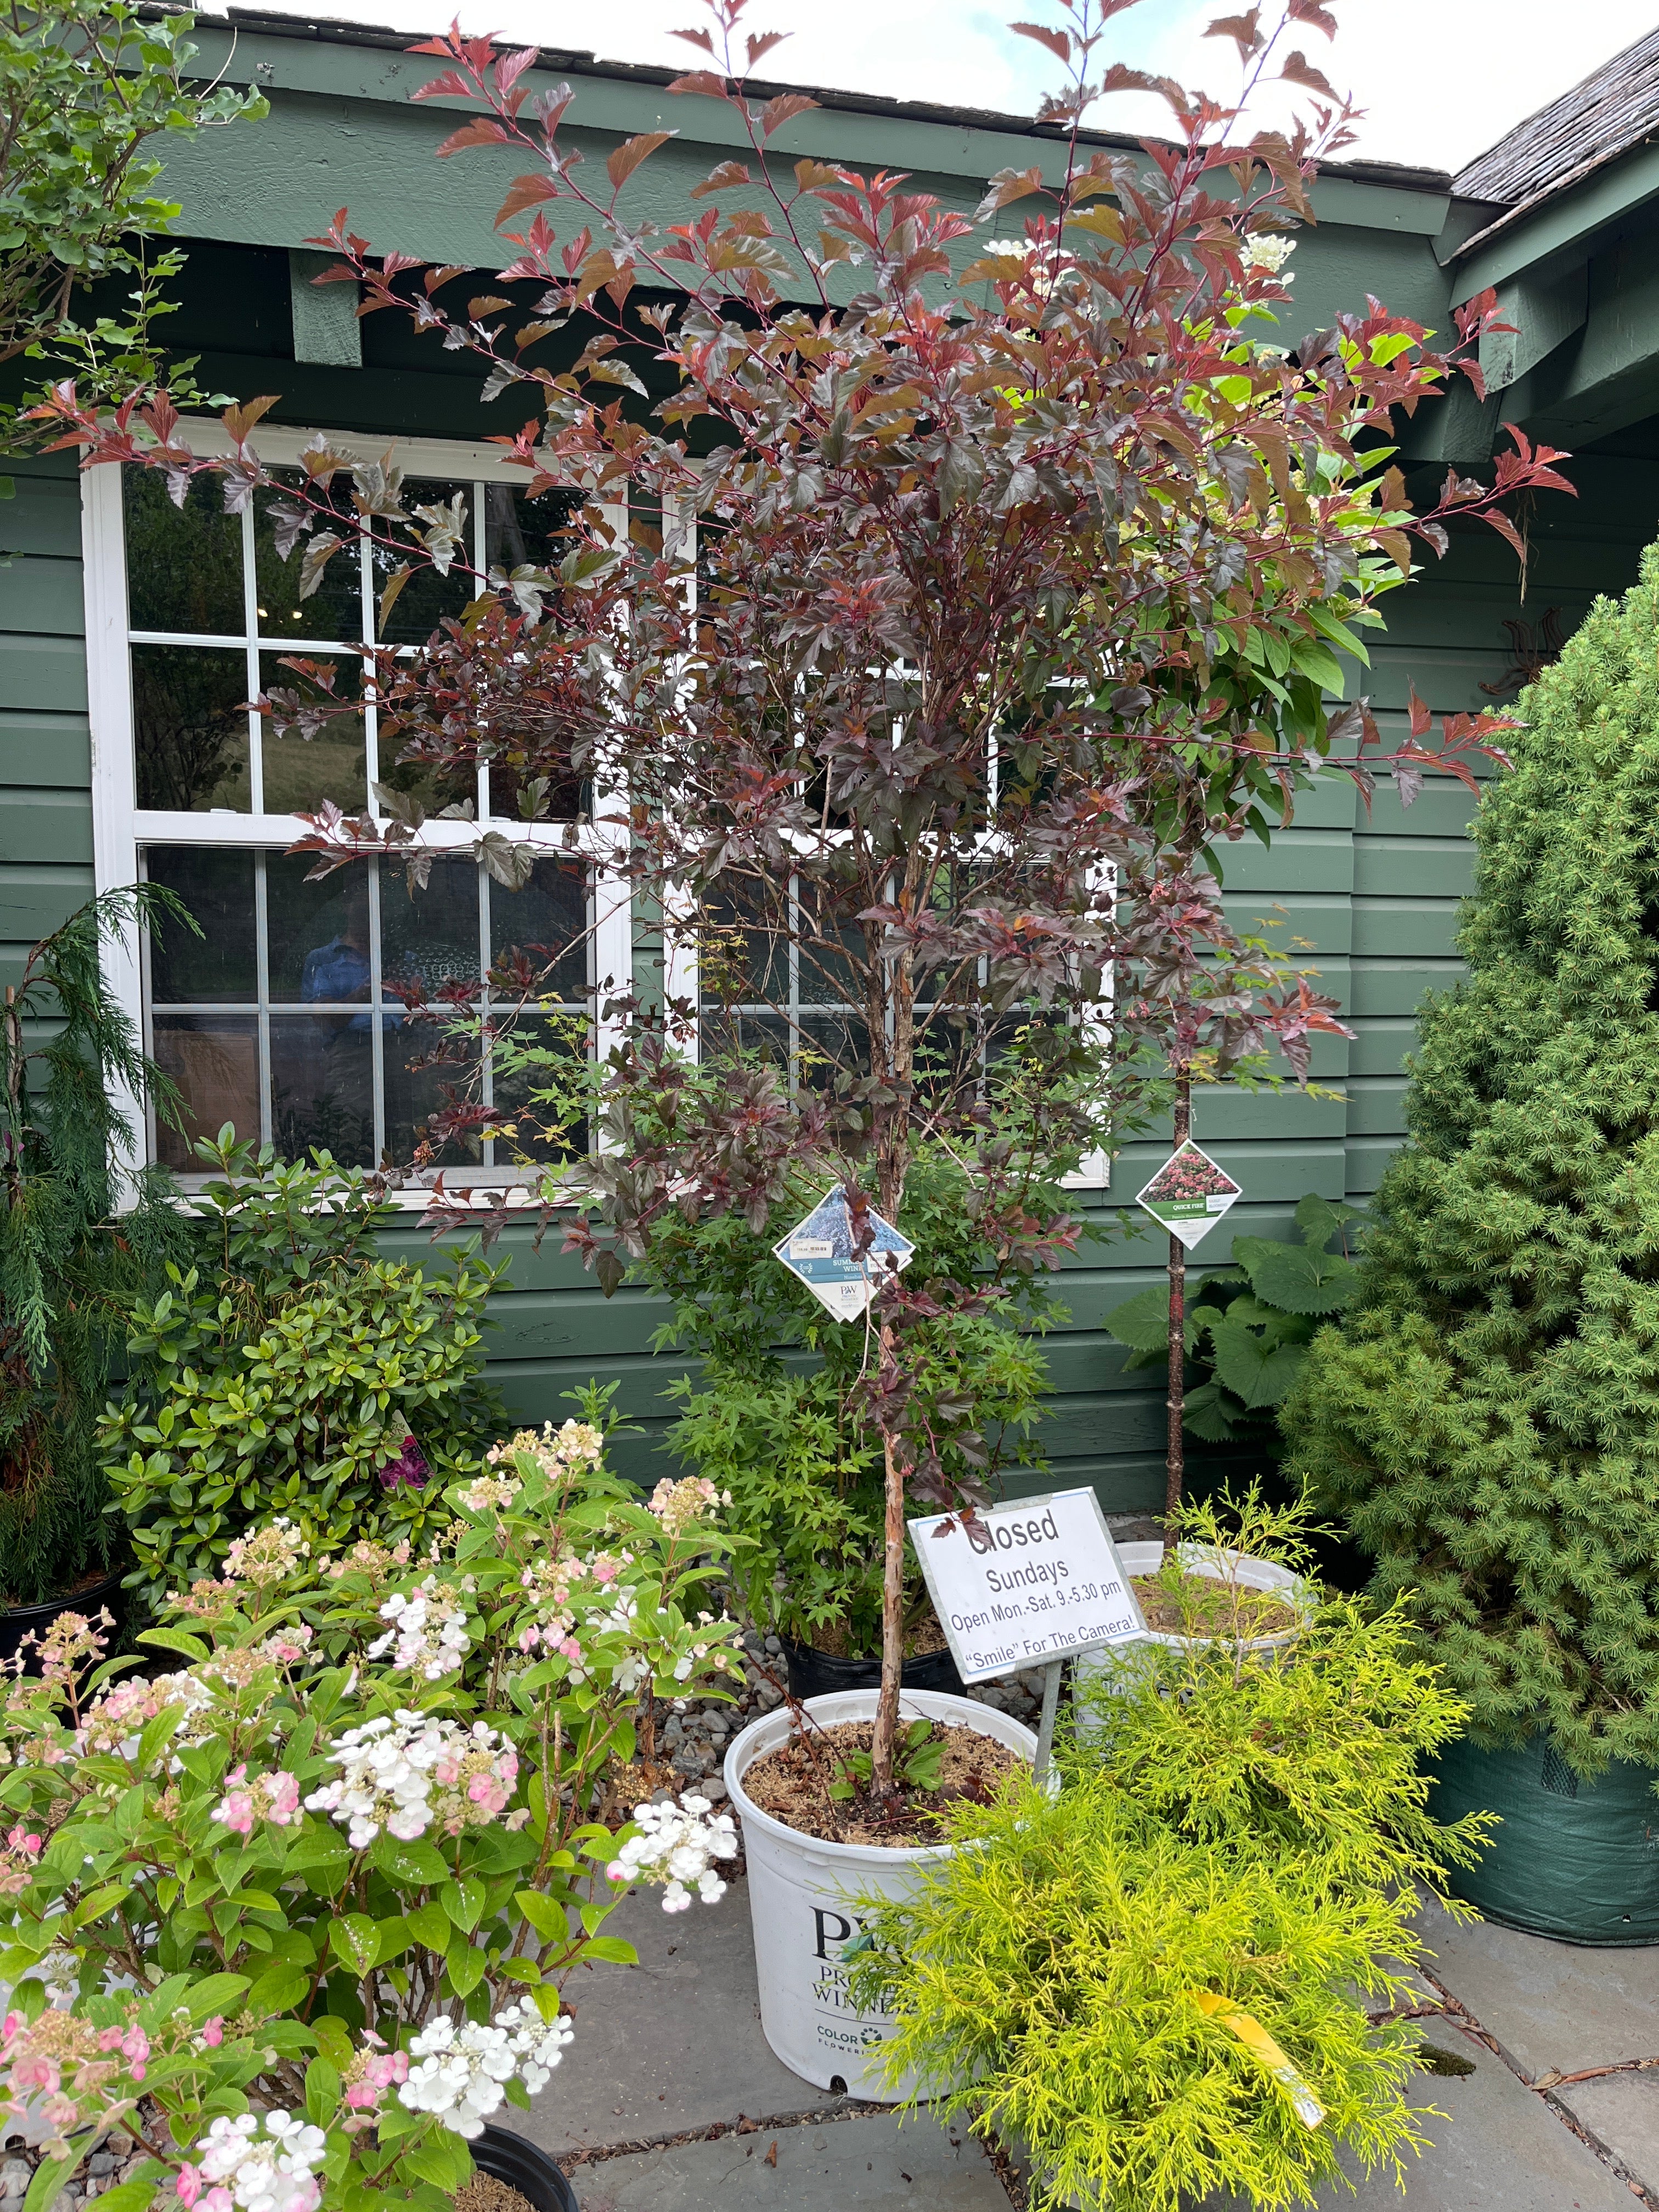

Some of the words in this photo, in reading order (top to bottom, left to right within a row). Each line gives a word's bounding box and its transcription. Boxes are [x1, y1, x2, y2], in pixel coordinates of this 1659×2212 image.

[986, 1561, 1069, 1593] Sundays
[951, 1611, 990, 1633] Open
[991, 1593, 1056, 1622] Mon.-Sat.
[1100, 1581, 1121, 1600] pm
[1023, 1639, 1047, 1655] For
[1049, 1632, 1076, 1647] The
[1079, 1615, 1135, 1641] Camera!
[817, 2025, 858, 2045] COLOR
